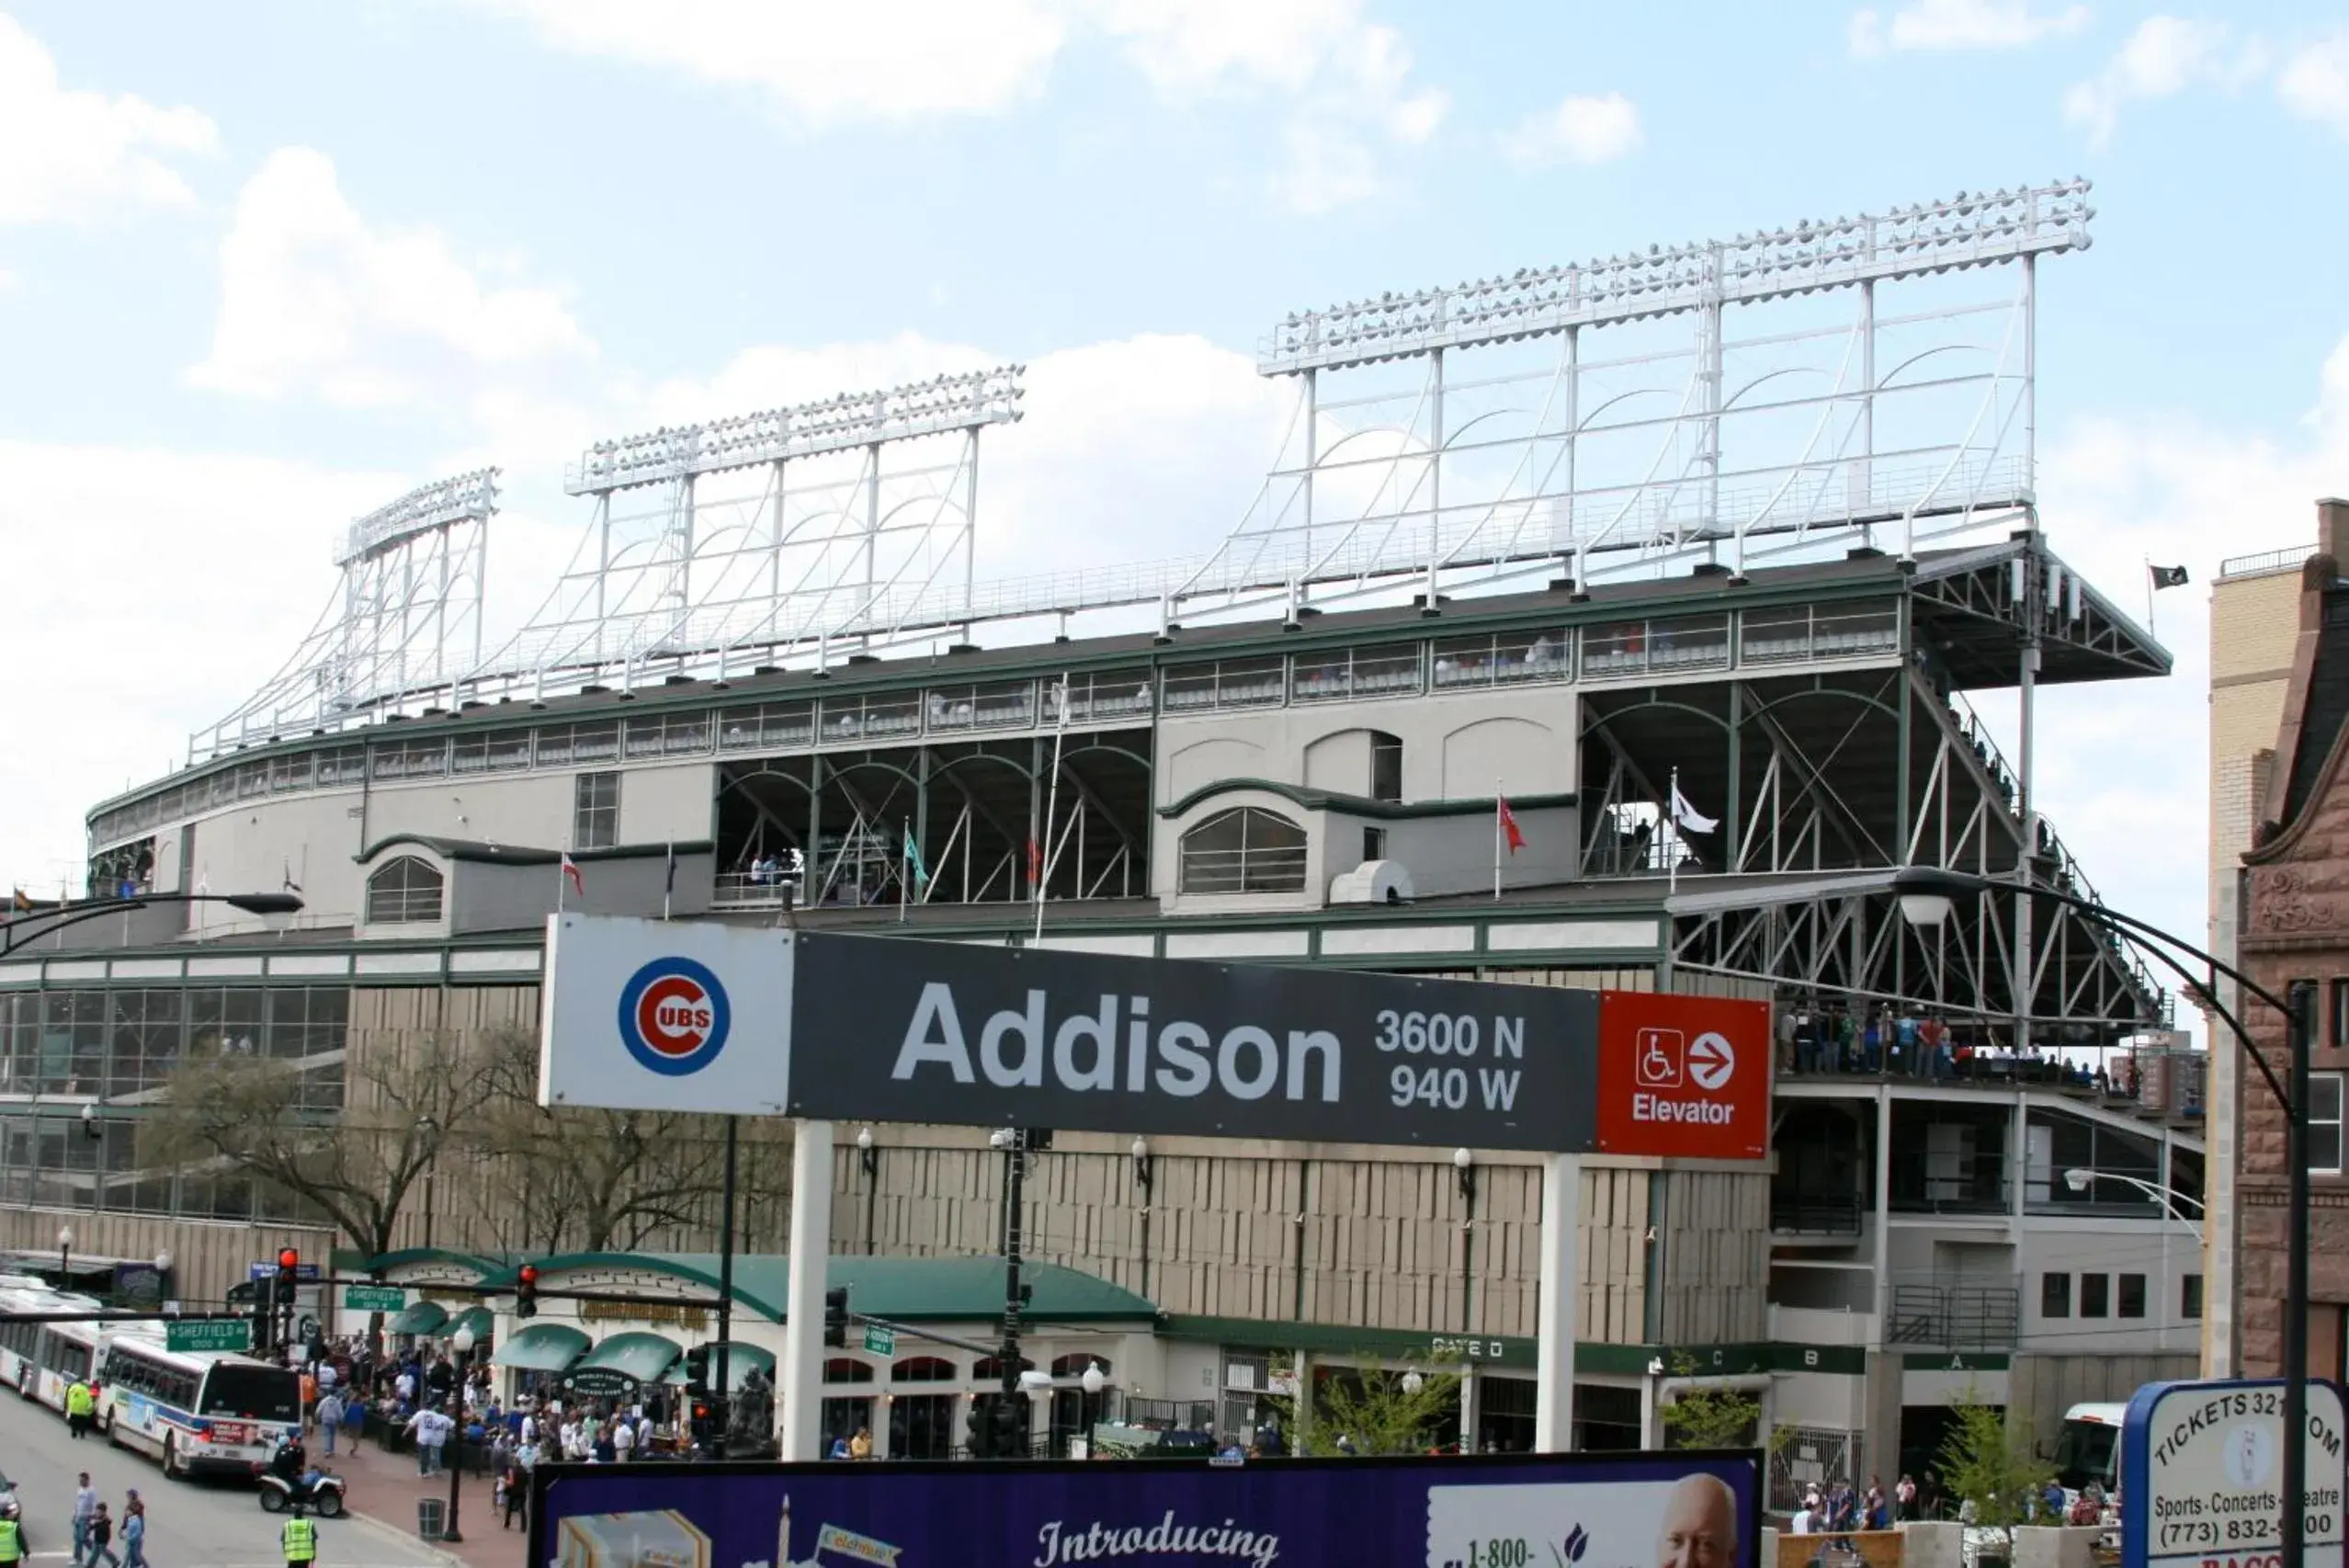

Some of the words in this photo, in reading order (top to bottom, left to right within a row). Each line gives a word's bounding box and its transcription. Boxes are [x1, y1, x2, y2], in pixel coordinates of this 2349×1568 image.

[891, 981, 1342, 1104] Addison
[1375, 1009, 1480, 1058] 3600
[1493, 1016, 1525, 1059] N
[1390, 1063, 1469, 1110] 940
[1481, 1068, 1522, 1112] W
[1631, 1092, 1735, 1126] Elevator
[178, 1324, 232, 1337] SHEFFIELD
[1713, 1351, 1722, 1365] C
[1805, 1350, 1818, 1365] B
[1951, 1355, 1963, 1369] A
[2155, 1494, 2202, 1521] Sports
[2211, 1491, 2276, 1513] Concerts
[1033, 1509, 1279, 1568] Introducing
[2161, 1521, 2218, 1548] (773)
[1469, 1538, 1536, 1568] 1-800-
